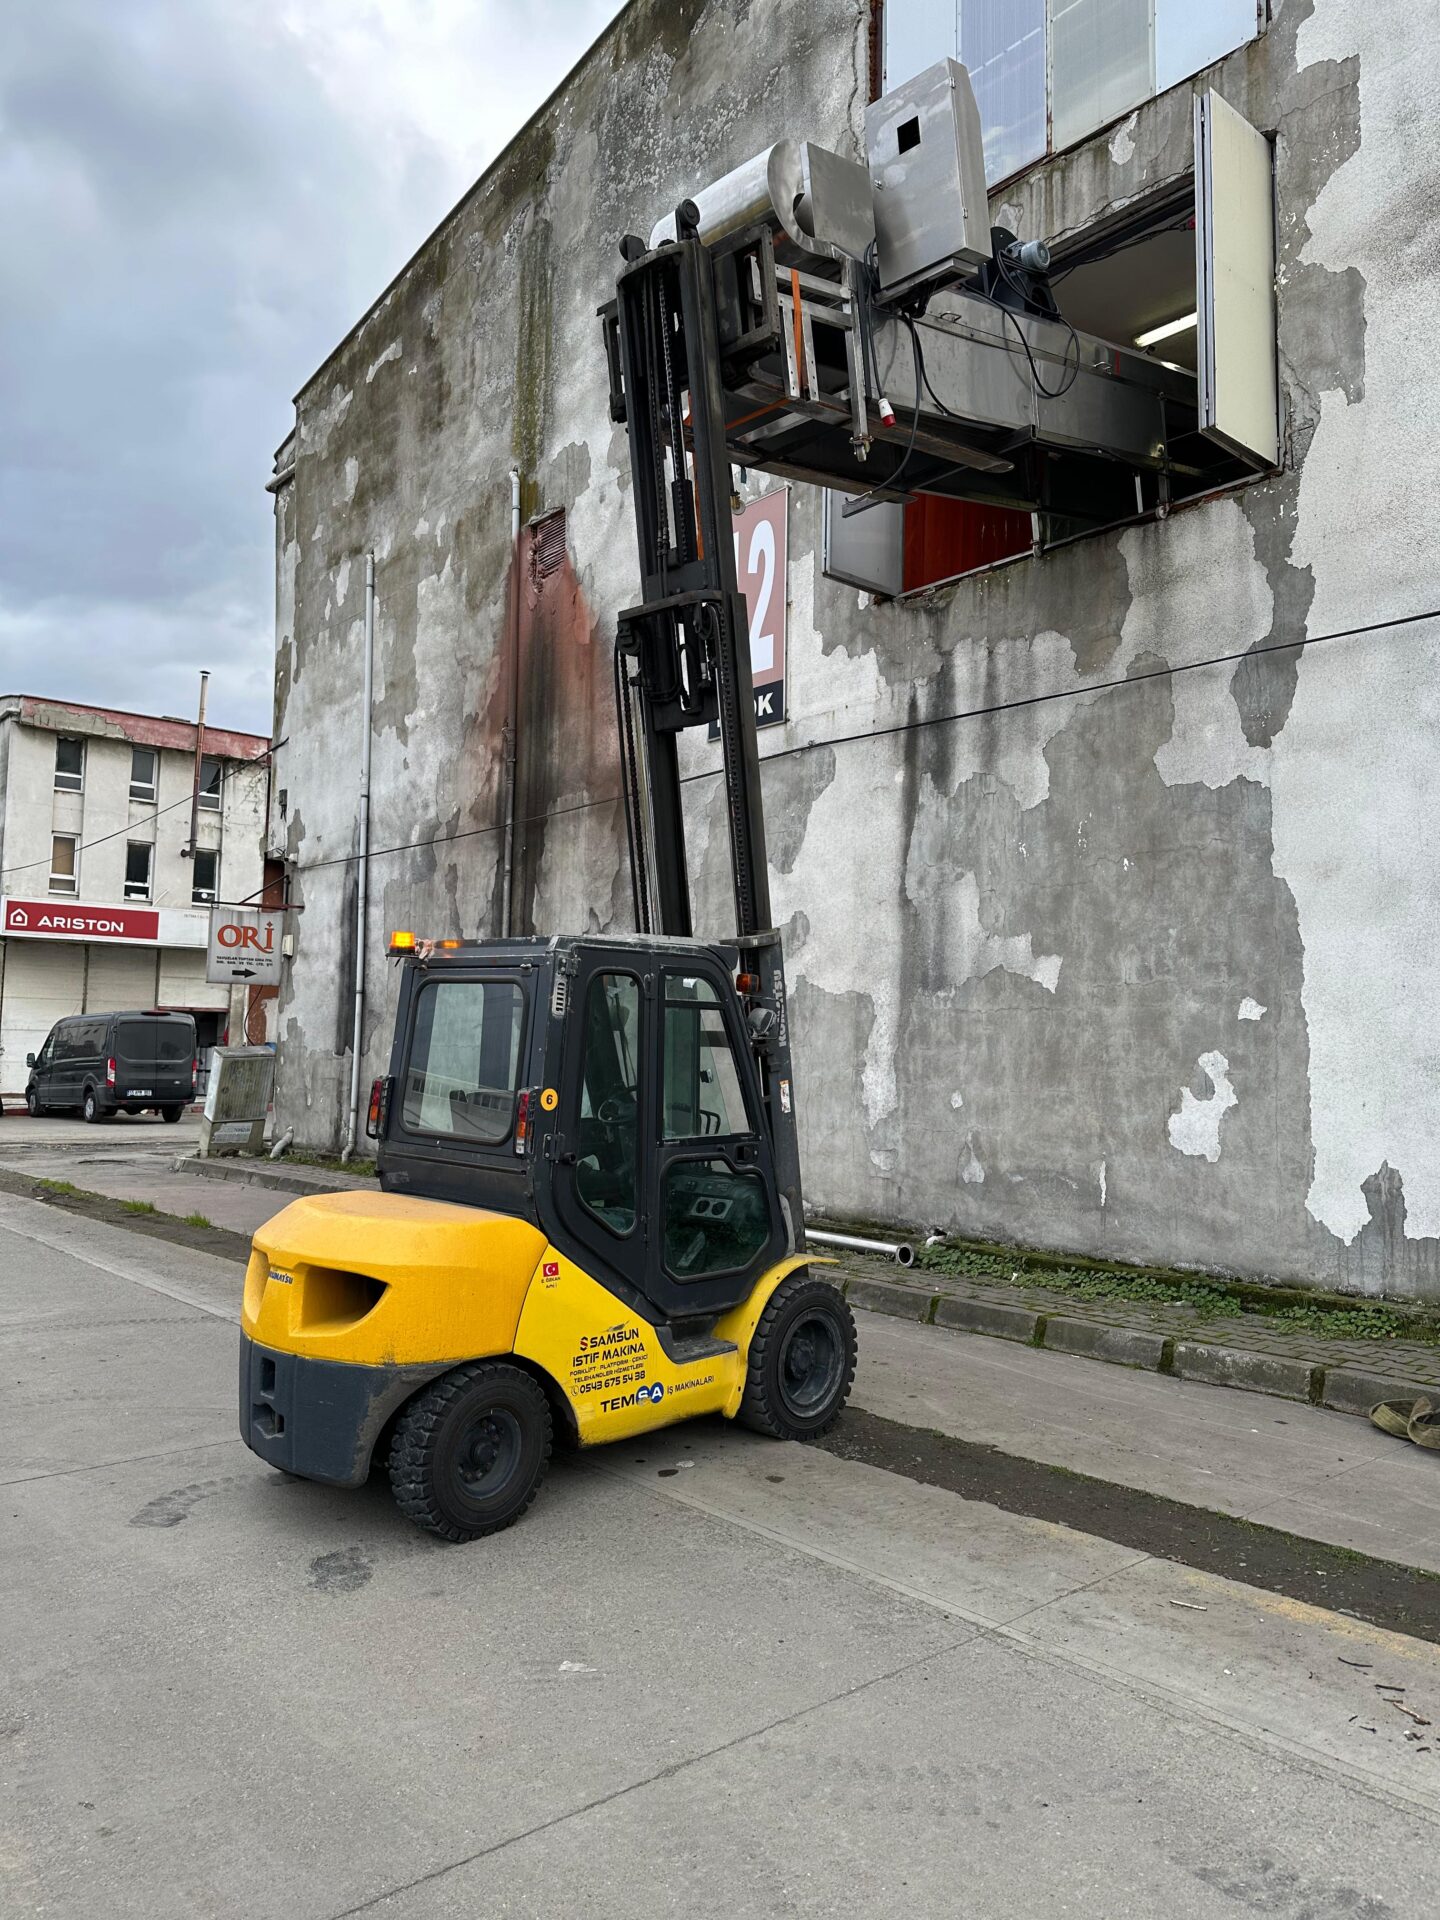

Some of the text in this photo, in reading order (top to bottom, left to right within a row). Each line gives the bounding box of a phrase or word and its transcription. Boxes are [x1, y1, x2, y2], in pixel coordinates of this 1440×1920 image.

[734, 519, 775, 674] 2
[37, 915, 124, 933] ARISTON
[546, 1094, 553, 1105] 6
[590, 1328, 639, 1348] SAMSUN
[600, 1359, 628, 1370] PLATFORM
[580, 1370, 646, 1394] 0543 675 54 38
[600, 1383, 664, 1413] TEMSA
